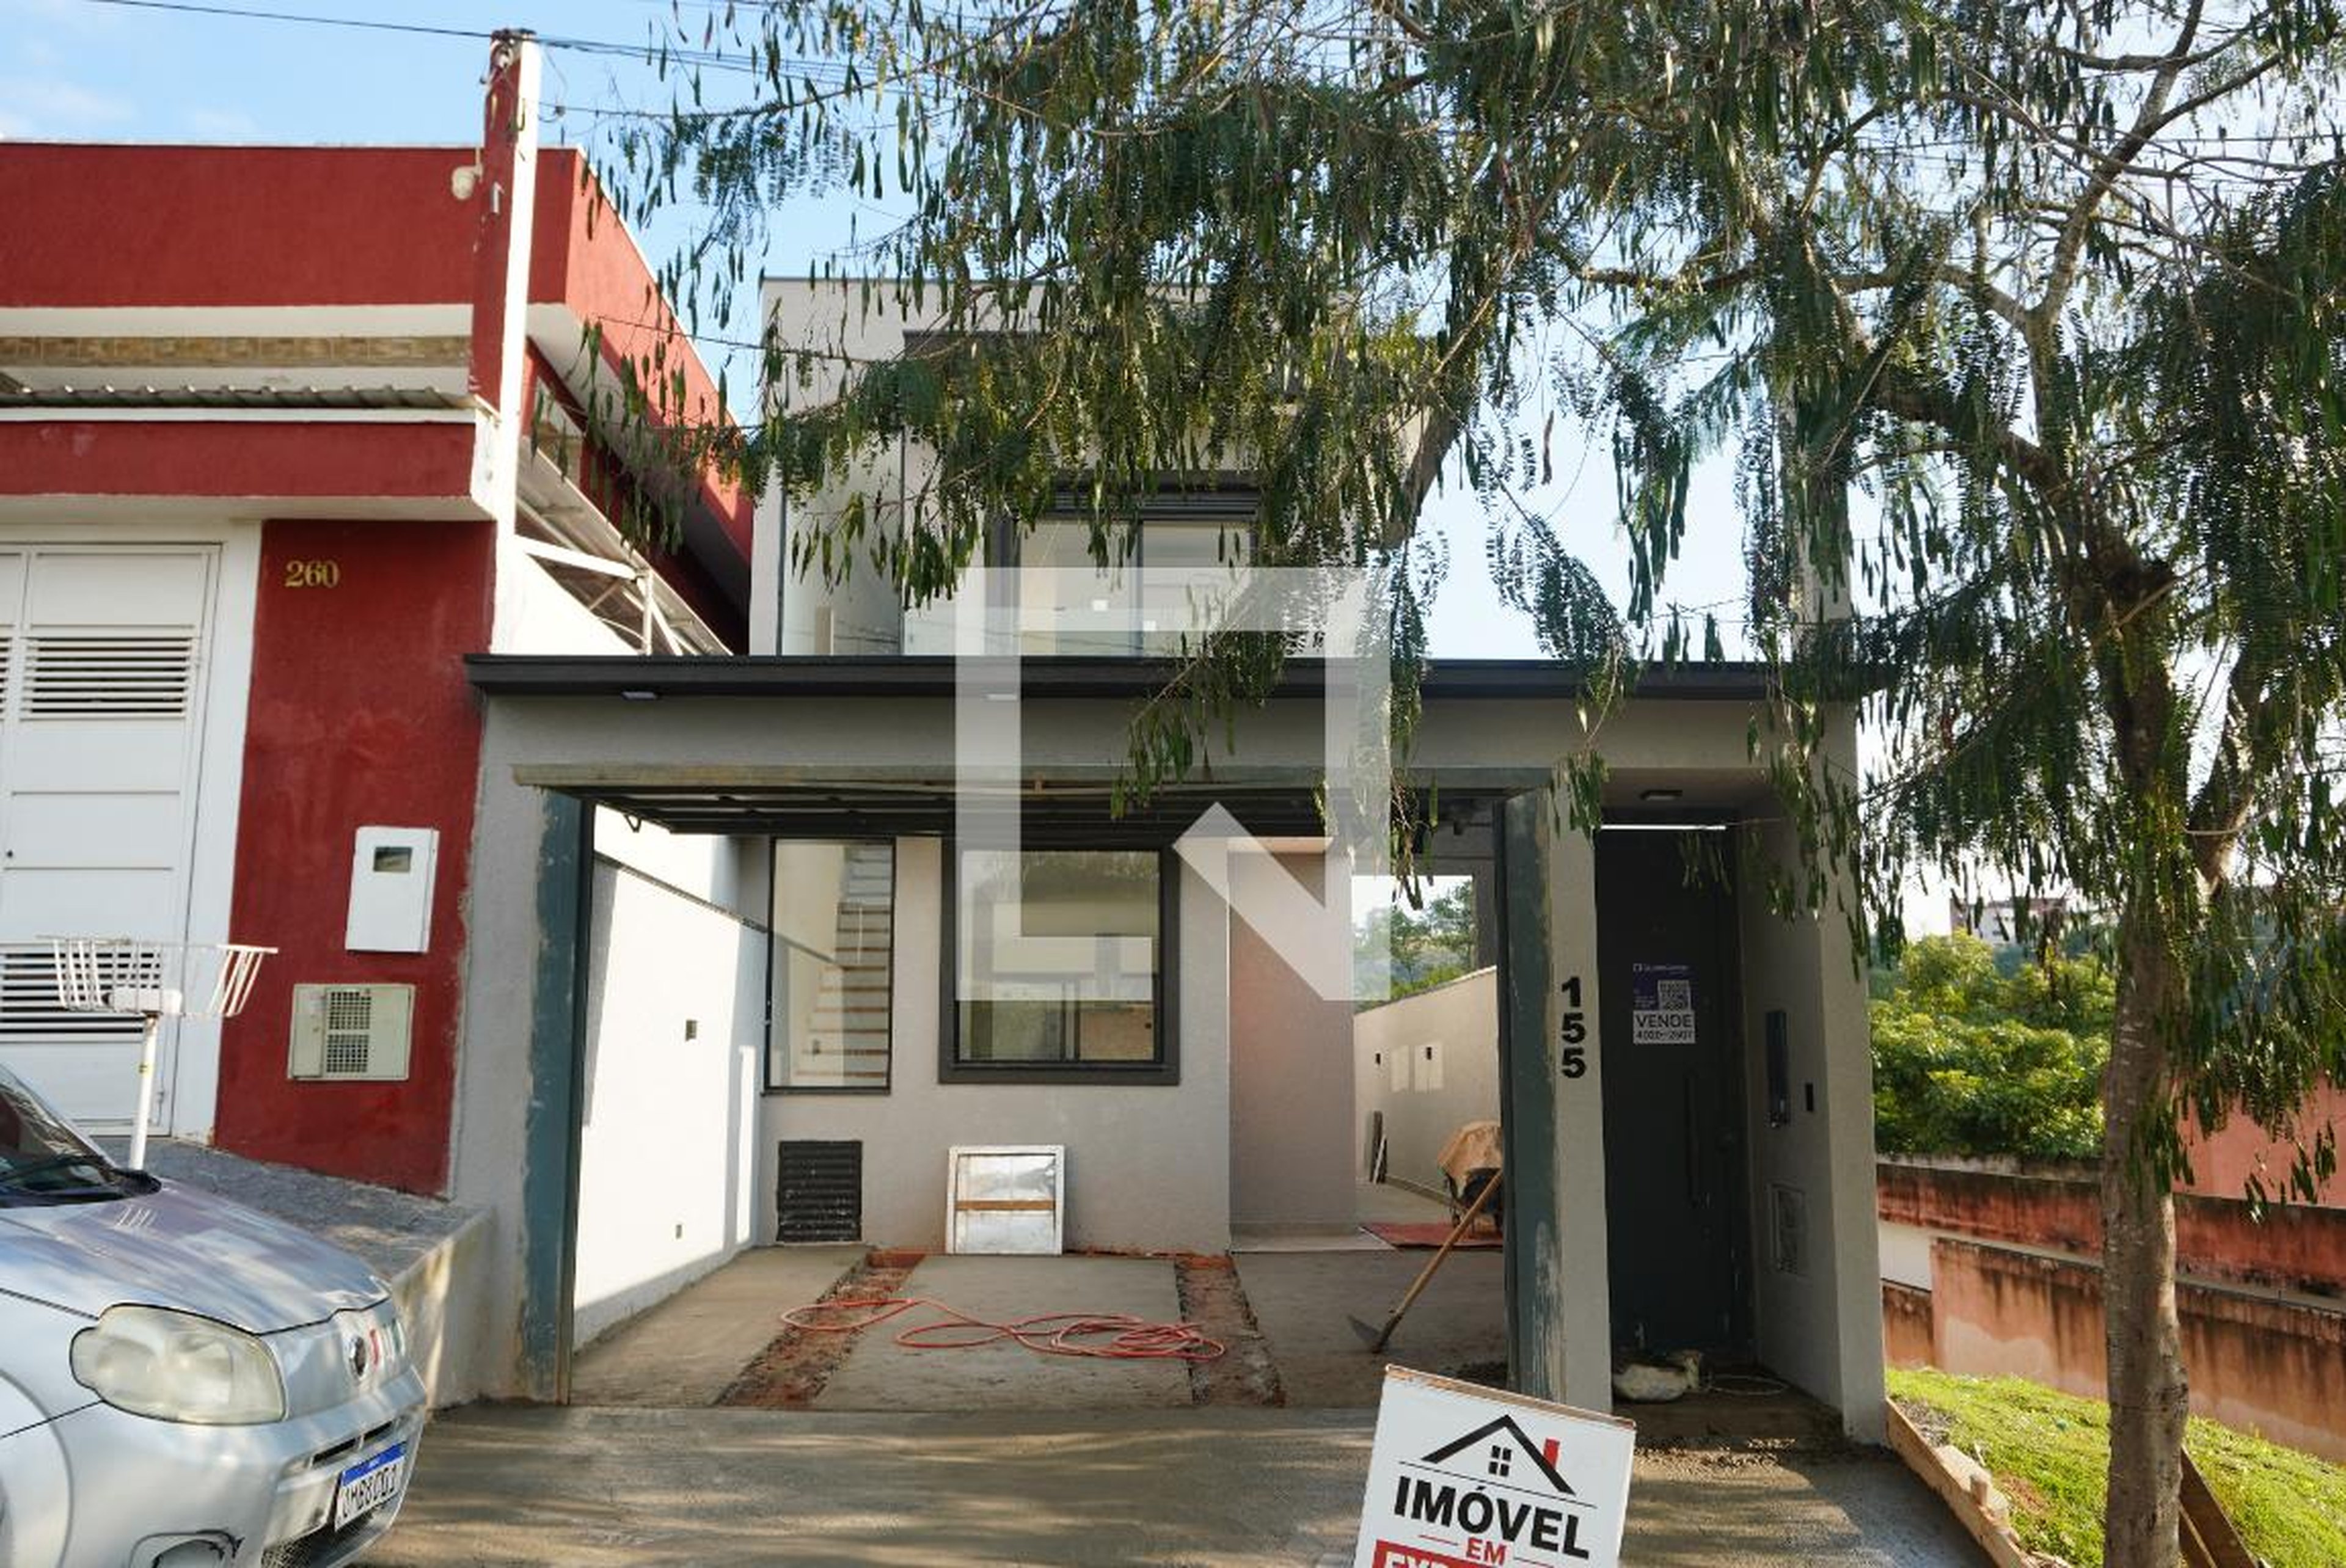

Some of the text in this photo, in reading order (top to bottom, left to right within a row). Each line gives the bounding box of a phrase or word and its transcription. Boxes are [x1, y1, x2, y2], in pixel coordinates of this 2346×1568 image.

[285, 560, 340, 588] 260
[1562, 976, 1586, 1079] 155
[1635, 1014, 1692, 1027] VENDE
[1394, 1476, 1590, 1560] IMÓVEL
[1466, 1537, 1507, 1566] EM
